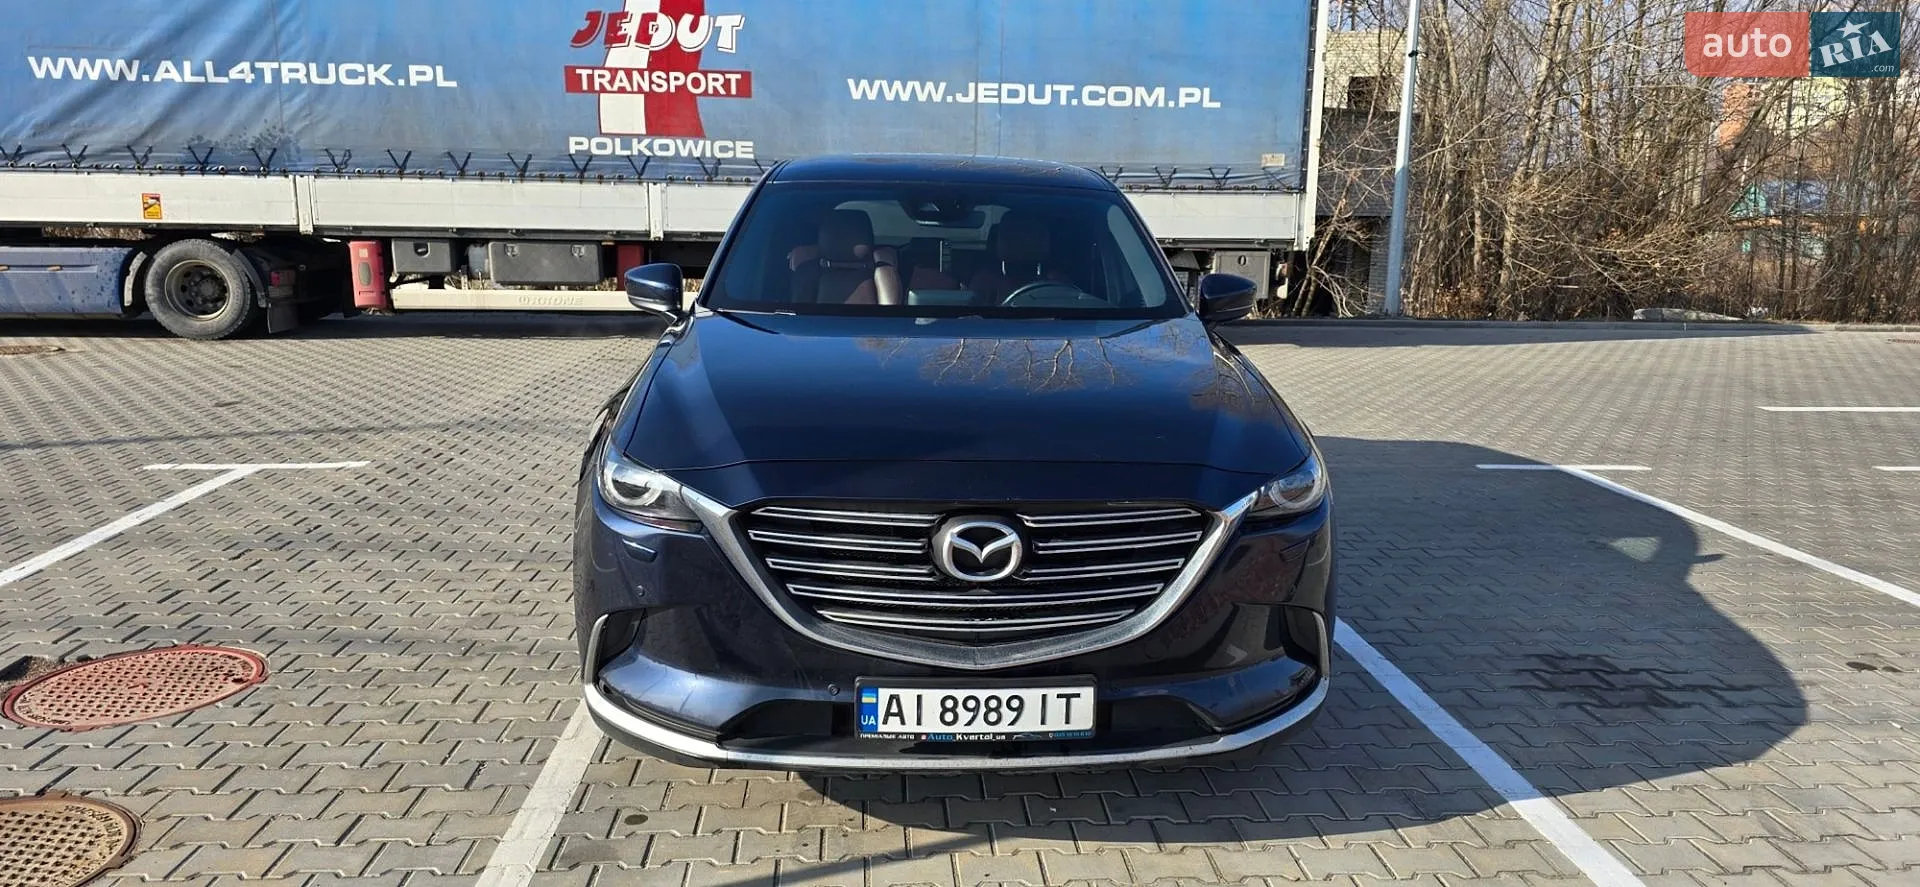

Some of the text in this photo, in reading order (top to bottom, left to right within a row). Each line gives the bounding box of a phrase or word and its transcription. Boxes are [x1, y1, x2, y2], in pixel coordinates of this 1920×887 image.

[570, 11, 745, 53] JEDUT
[27, 56, 458, 88] WWW.ALL4TRUCK.PL
[575, 68, 742, 96] TRANSPORT
[847, 78, 1222, 109] WWW.JEDUT.COM.PL
[568, 136, 755, 159] POLKOWICE
[861, 715, 877, 726] UA
[882, 693, 1081, 727] AI 8989 IT
